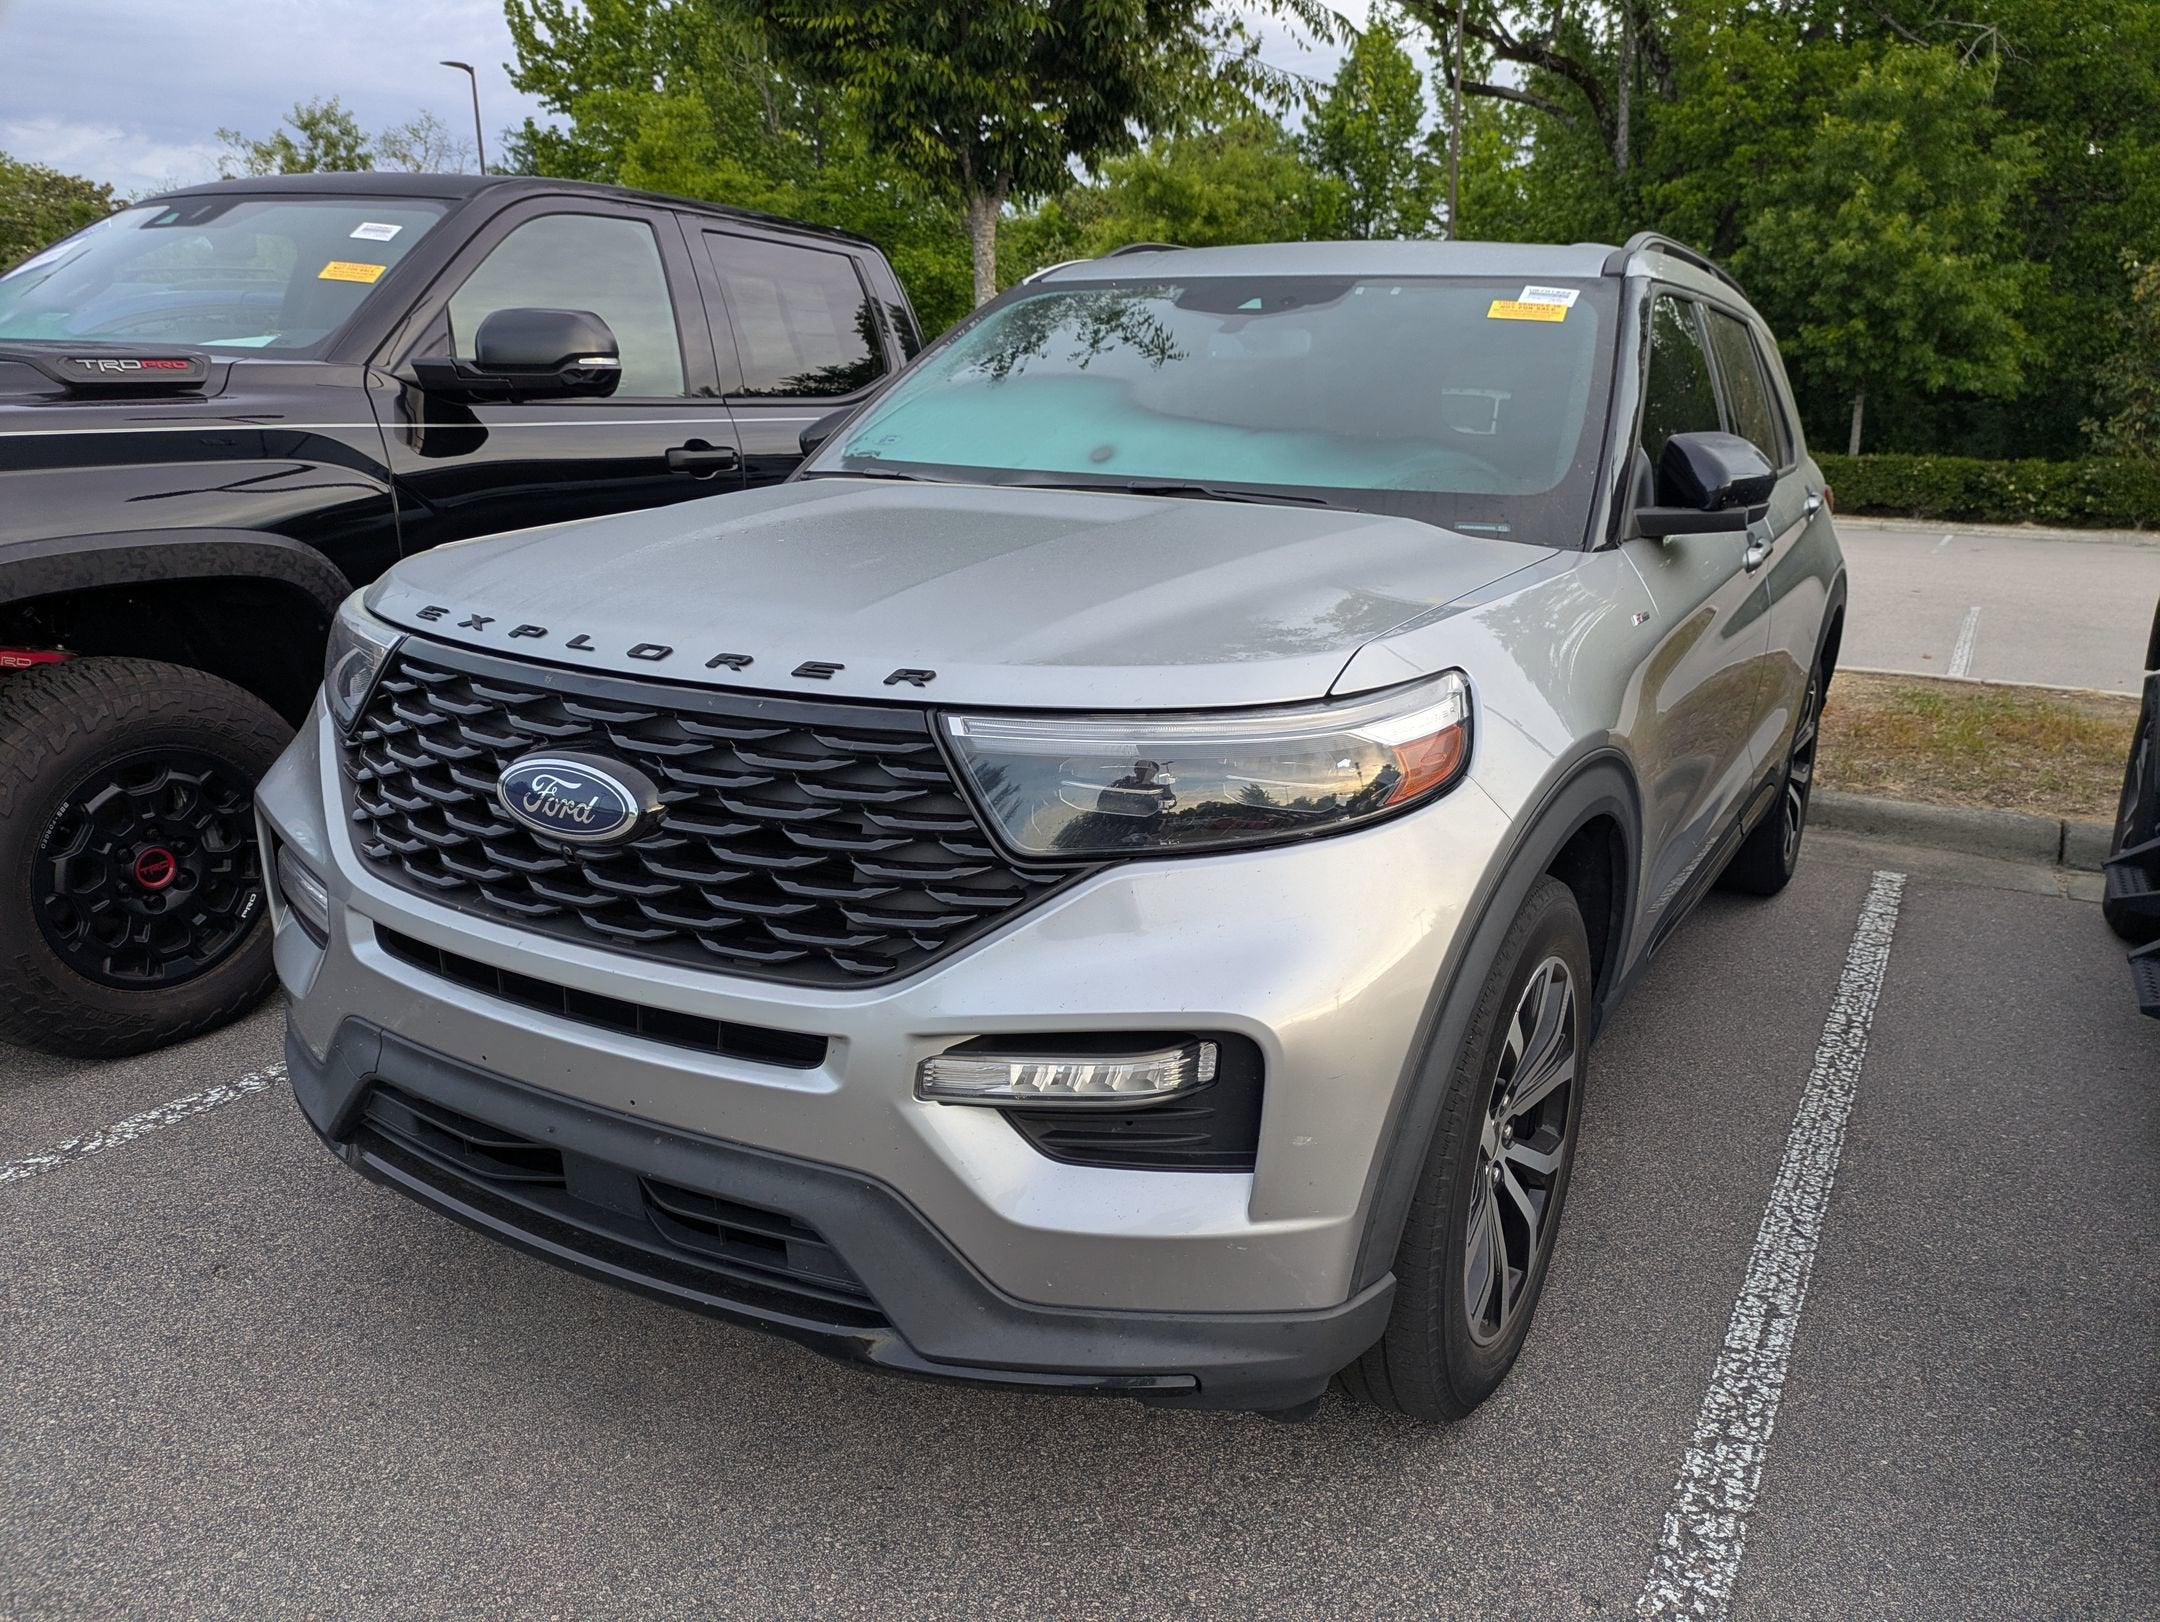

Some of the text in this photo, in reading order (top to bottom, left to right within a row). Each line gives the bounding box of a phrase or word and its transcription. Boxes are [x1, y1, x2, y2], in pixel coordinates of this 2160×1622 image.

[75, 359, 189, 373] TRD PRO
[416, 604, 938, 688] EXPLORER
[523, 773, 599, 825] Ford
[240, 893, 257, 919] PRO
